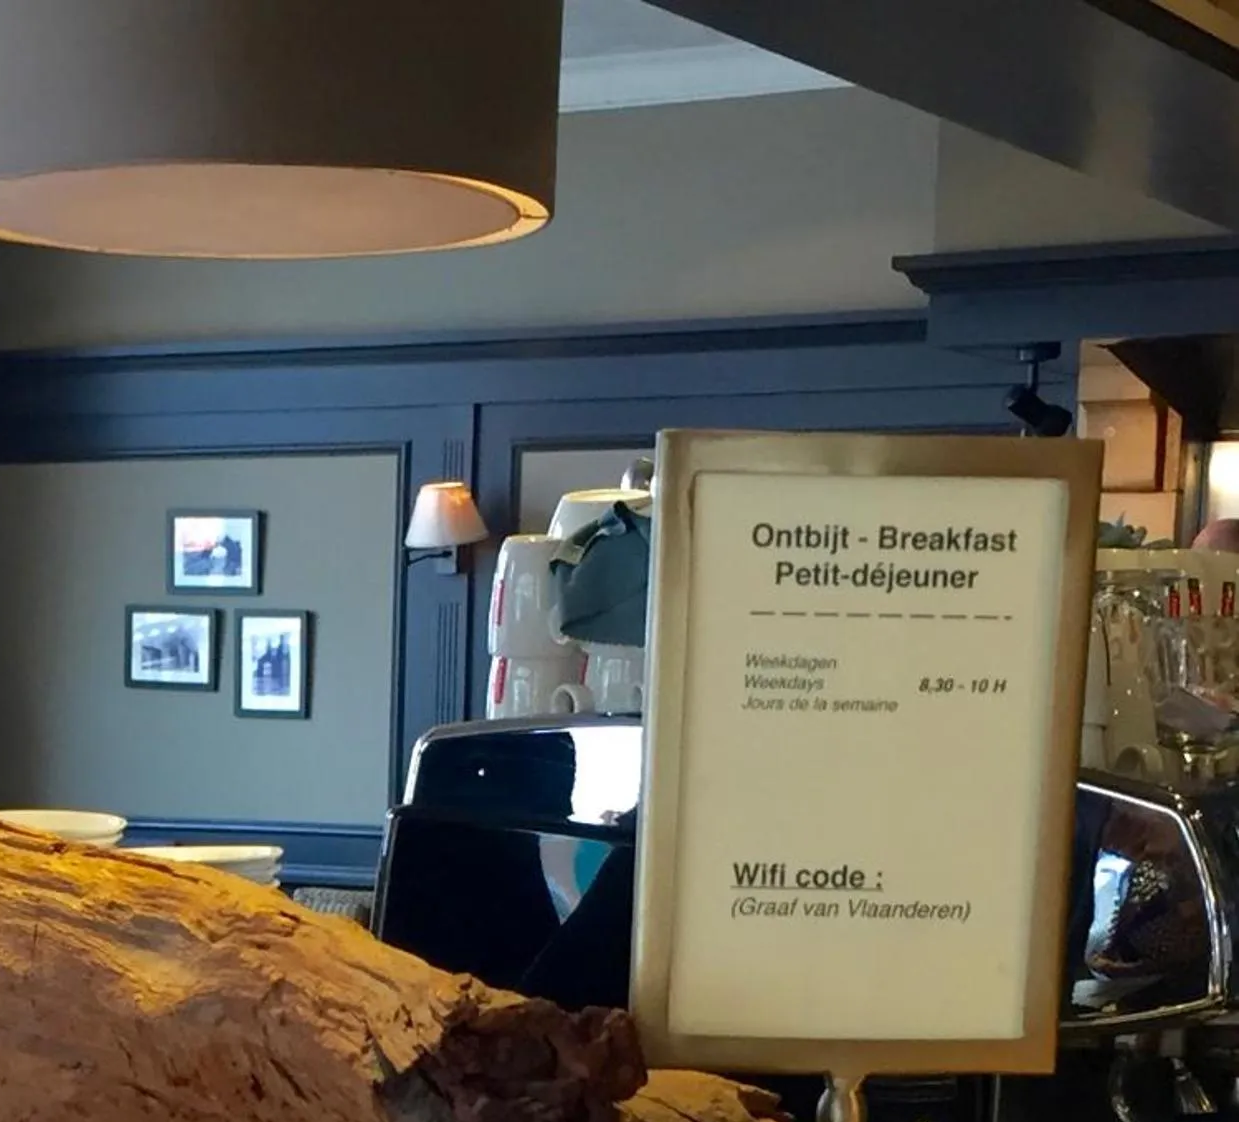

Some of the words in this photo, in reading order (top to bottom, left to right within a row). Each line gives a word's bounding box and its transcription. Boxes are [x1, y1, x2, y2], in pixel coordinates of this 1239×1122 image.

[752, 523, 850, 555] Ontbijt
[878, 525, 1018, 553] Breakfast
[775, 561, 979, 594] Petit-déjeuner
[745, 653, 838, 671] Weekdagen
[744, 675, 825, 693] Weekdays
[970, 678, 989, 693] 10
[992, 678, 1007, 694] H
[741, 697, 785, 711] Jours
[789, 697, 809, 712] de
[813, 697, 828, 712] la
[831, 699, 899, 713] semaine
[732, 862, 786, 888] Wifi
[795, 864, 866, 890] code
[731, 897, 799, 919] (Graaf
[804, 902, 840, 917] van
[848, 899, 972, 924] Vlaanderen)
